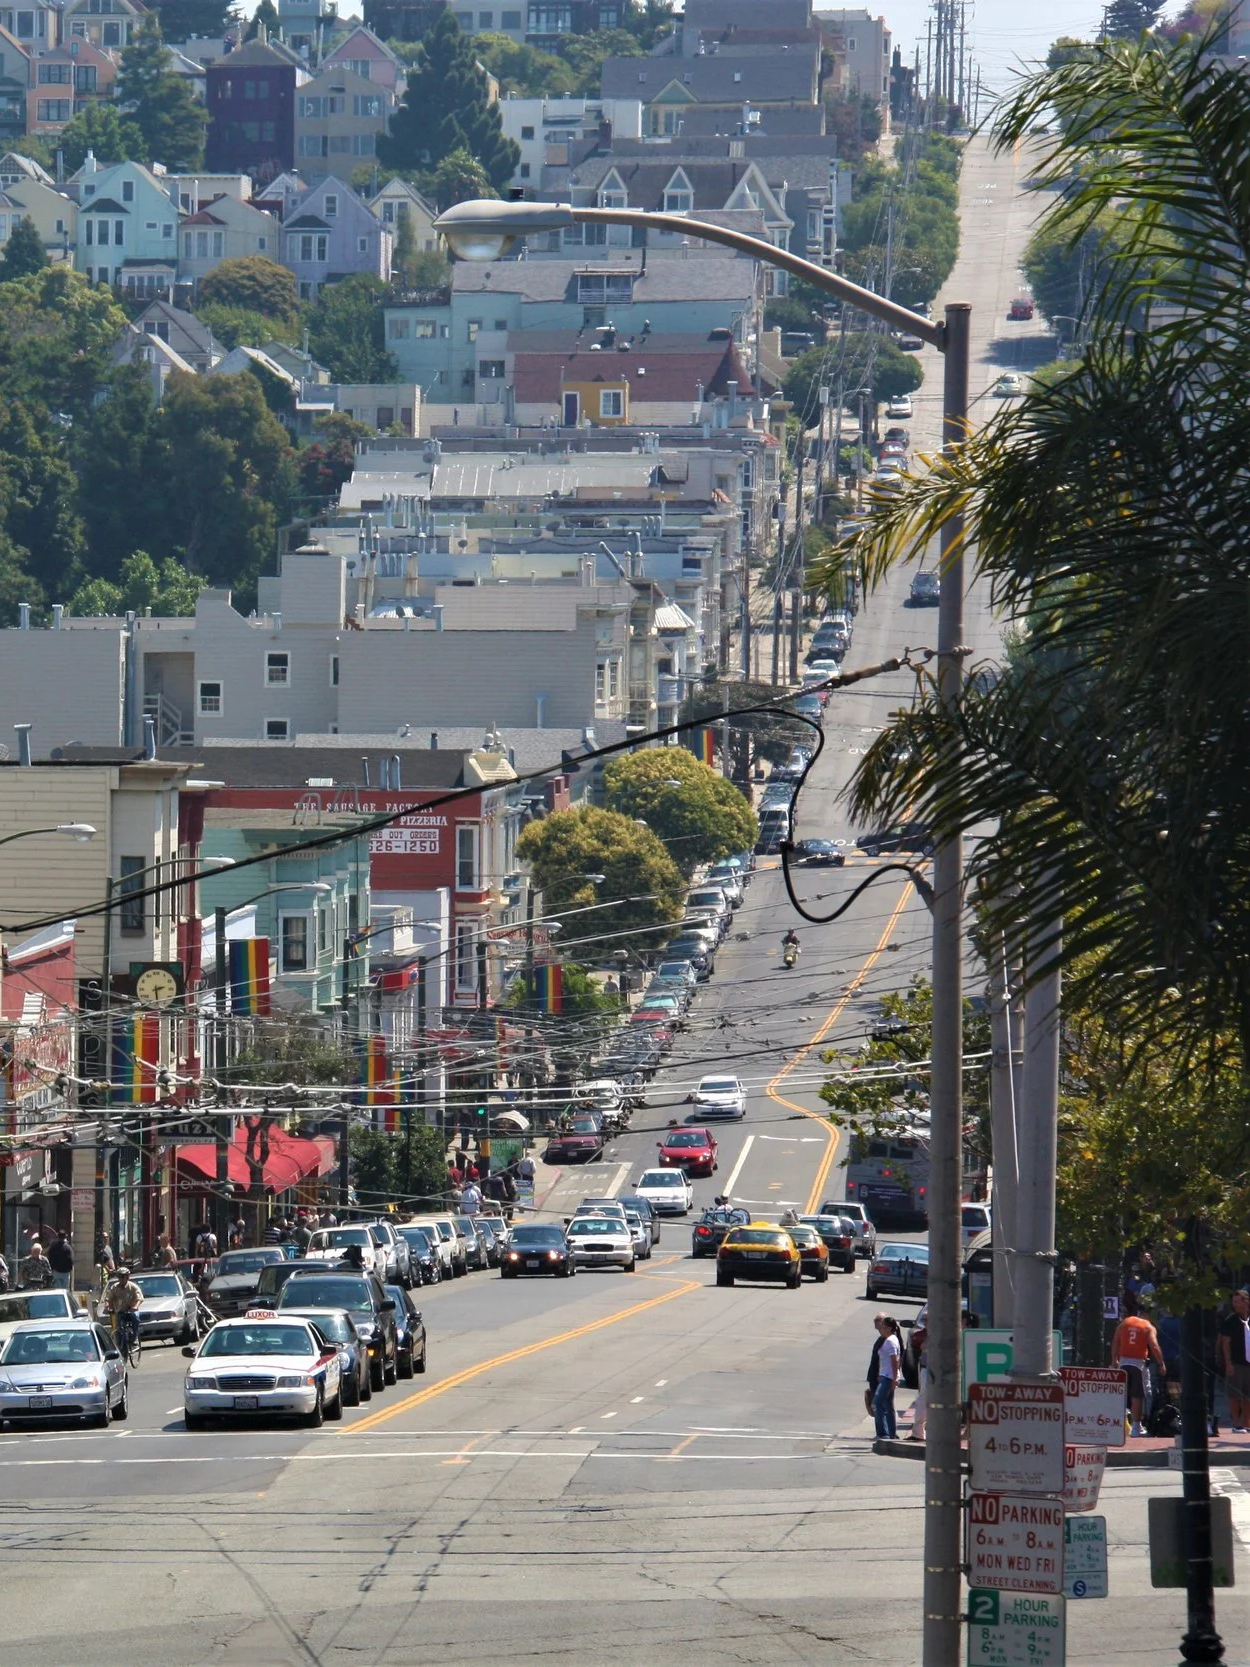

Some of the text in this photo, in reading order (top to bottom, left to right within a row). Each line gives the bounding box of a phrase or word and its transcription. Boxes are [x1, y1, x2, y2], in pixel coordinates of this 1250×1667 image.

[326, 802, 377, 813] SAUSAGE
[400, 816, 449, 826] PIZZERIA
[389, 831, 403, 839] OUT
[409, 831, 437, 839] ORDERS
[976, 1342, 1014, 1382] P
[1064, 1369, 1120, 1381] TOW-AWAY
[979, 1386, 1053, 1400] TOW-AWAY
[1080, 1382, 1124, 1395] STOPPING
[971, 1400, 1061, 1422] NO STOPPING
[984, 1436, 997, 1453] 4
[971, 1497, 1061, 1526] NO PARKING
[977, 1552, 1055, 1573] MON WED FRI
[975, 1575, 1055, 1591] STREET CLEANING
[974, 1595, 1049, 1619] 2 HOUR
[1004, 1613, 1059, 1628] PARKING
